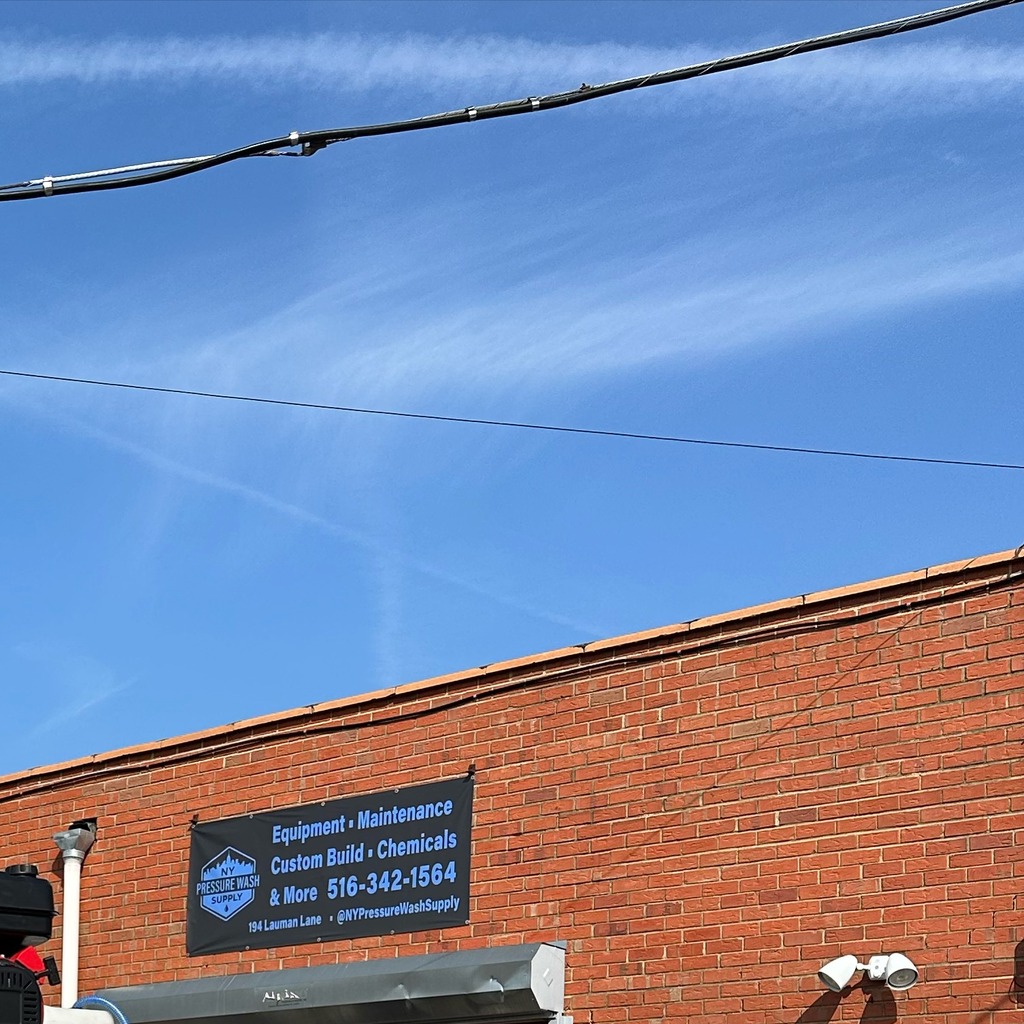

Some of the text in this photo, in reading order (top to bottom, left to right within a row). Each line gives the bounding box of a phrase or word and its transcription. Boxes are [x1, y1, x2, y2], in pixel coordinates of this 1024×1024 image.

[272, 800, 453, 847] Equipment Maintenance
[270, 829, 457, 875] Custom Build Chemicals
[196, 874, 260, 896] PRESSURE WASH
[221, 866, 235, 877] NY
[269, 861, 456, 907] & More 516-342-1564
[211, 892, 243, 905] SUPPLY
[248, 895, 460, 933] 194 Lauman Lane @NYPressureWashSupply
